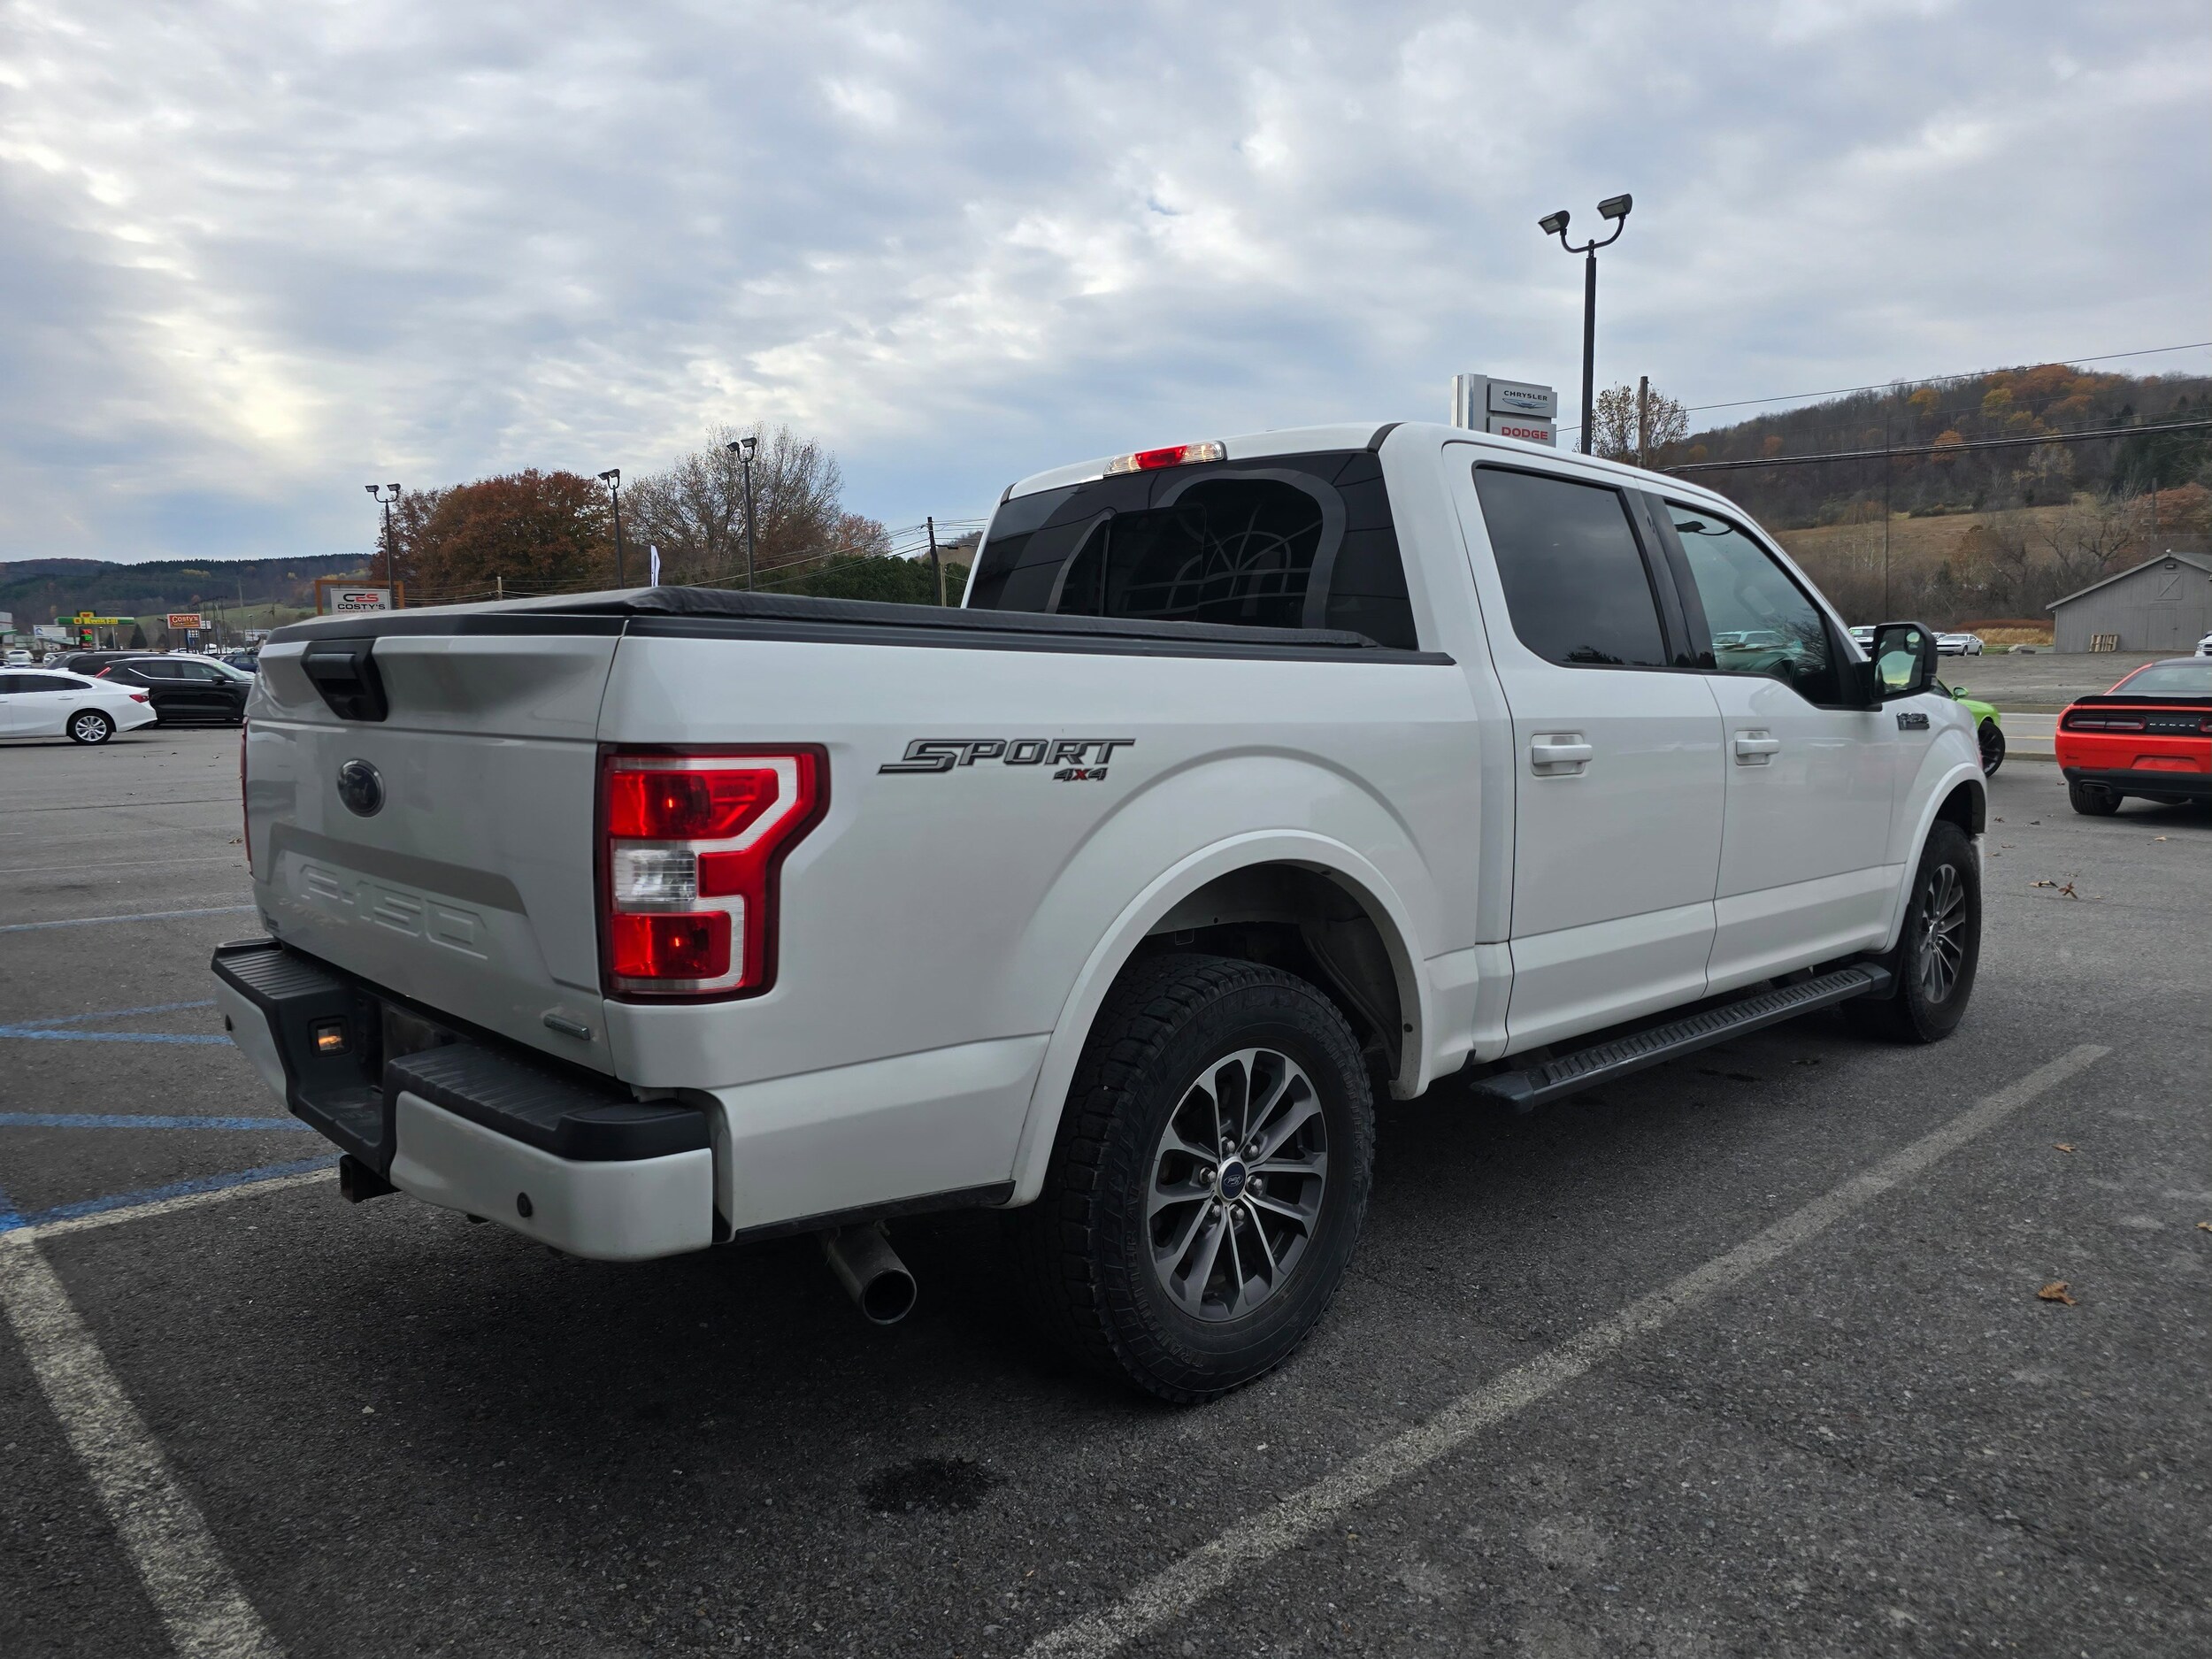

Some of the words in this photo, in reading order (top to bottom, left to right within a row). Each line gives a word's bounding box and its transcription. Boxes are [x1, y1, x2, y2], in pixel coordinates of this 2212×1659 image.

[1503, 390, 1548, 401] CHRYSLER
[1501, 426, 1548, 440] DODGE
[876, 738, 1136, 775] SPORT
[299, 864, 489, 960] F-150
